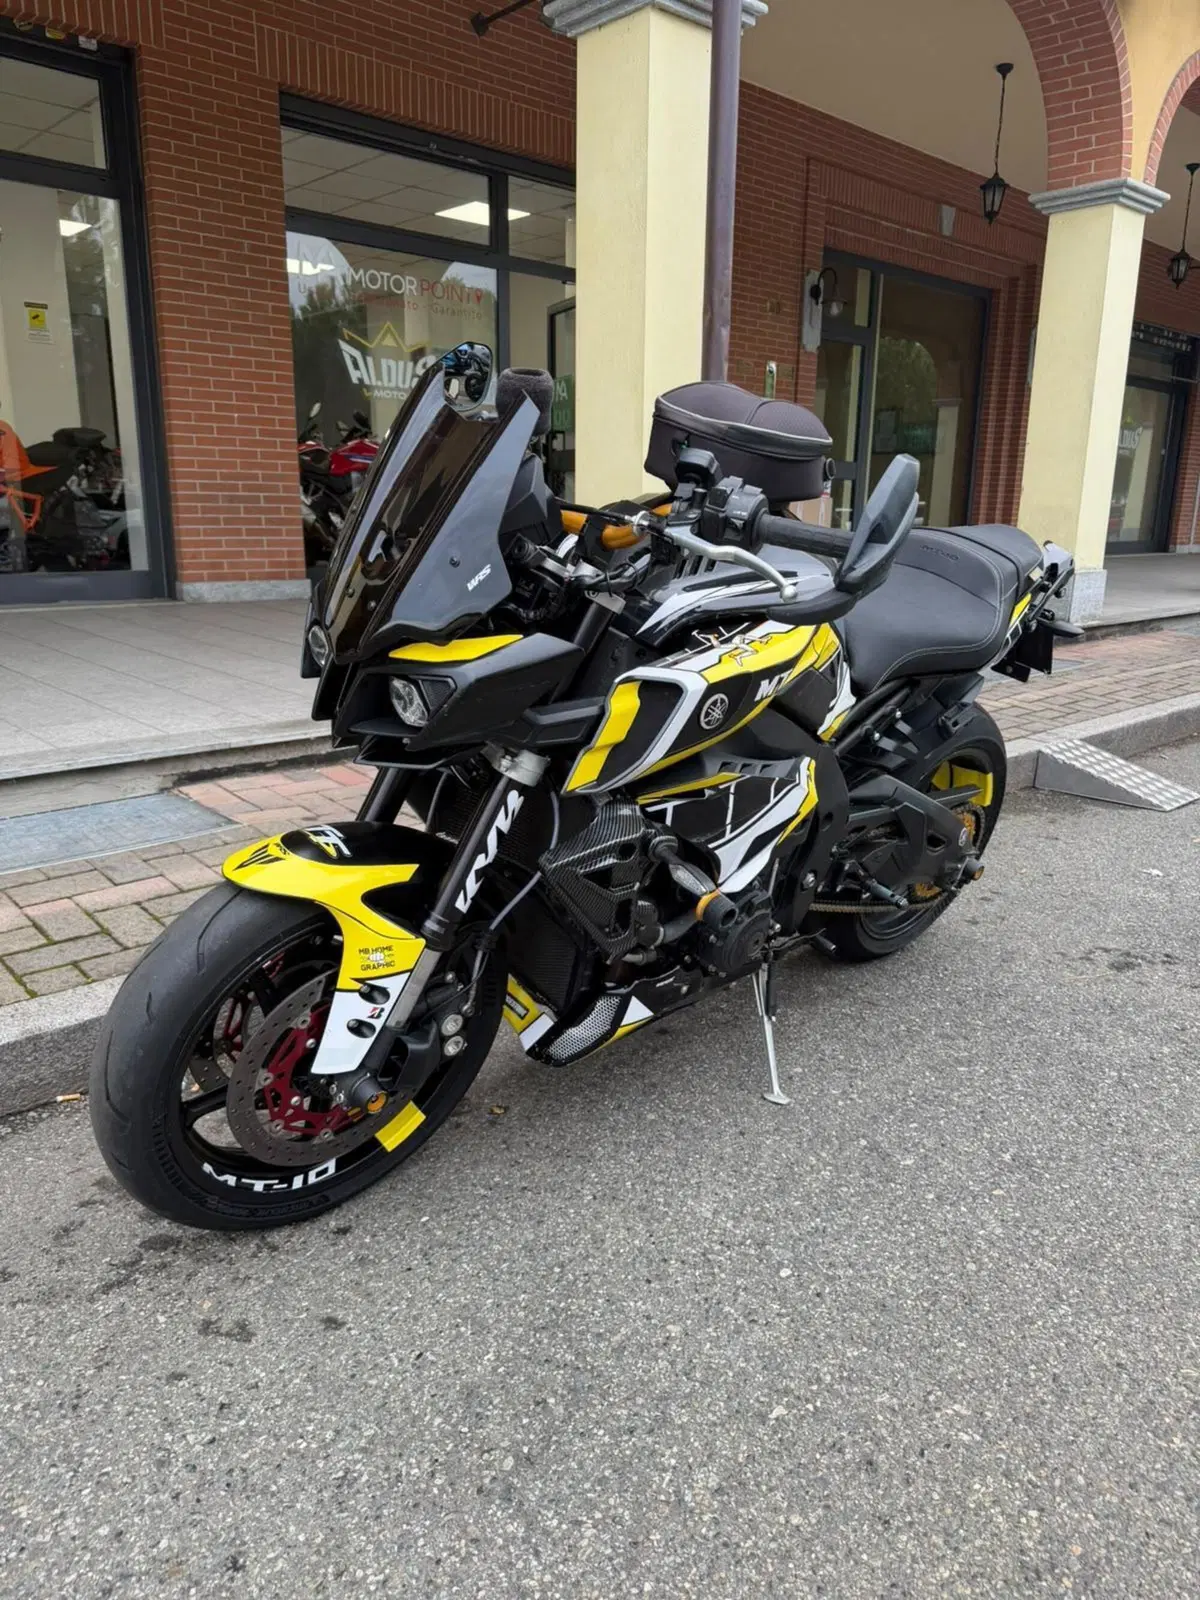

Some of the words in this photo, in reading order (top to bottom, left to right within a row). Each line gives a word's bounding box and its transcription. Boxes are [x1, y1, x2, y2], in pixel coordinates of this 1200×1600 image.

[1119, 427, 1142, 449] LDUS
[467, 564, 491, 592] WRS
[372, 945, 394, 954] HOME
[360, 960, 395, 971] GRAPHIC
[202, 1158, 336, 1192] MT-10
